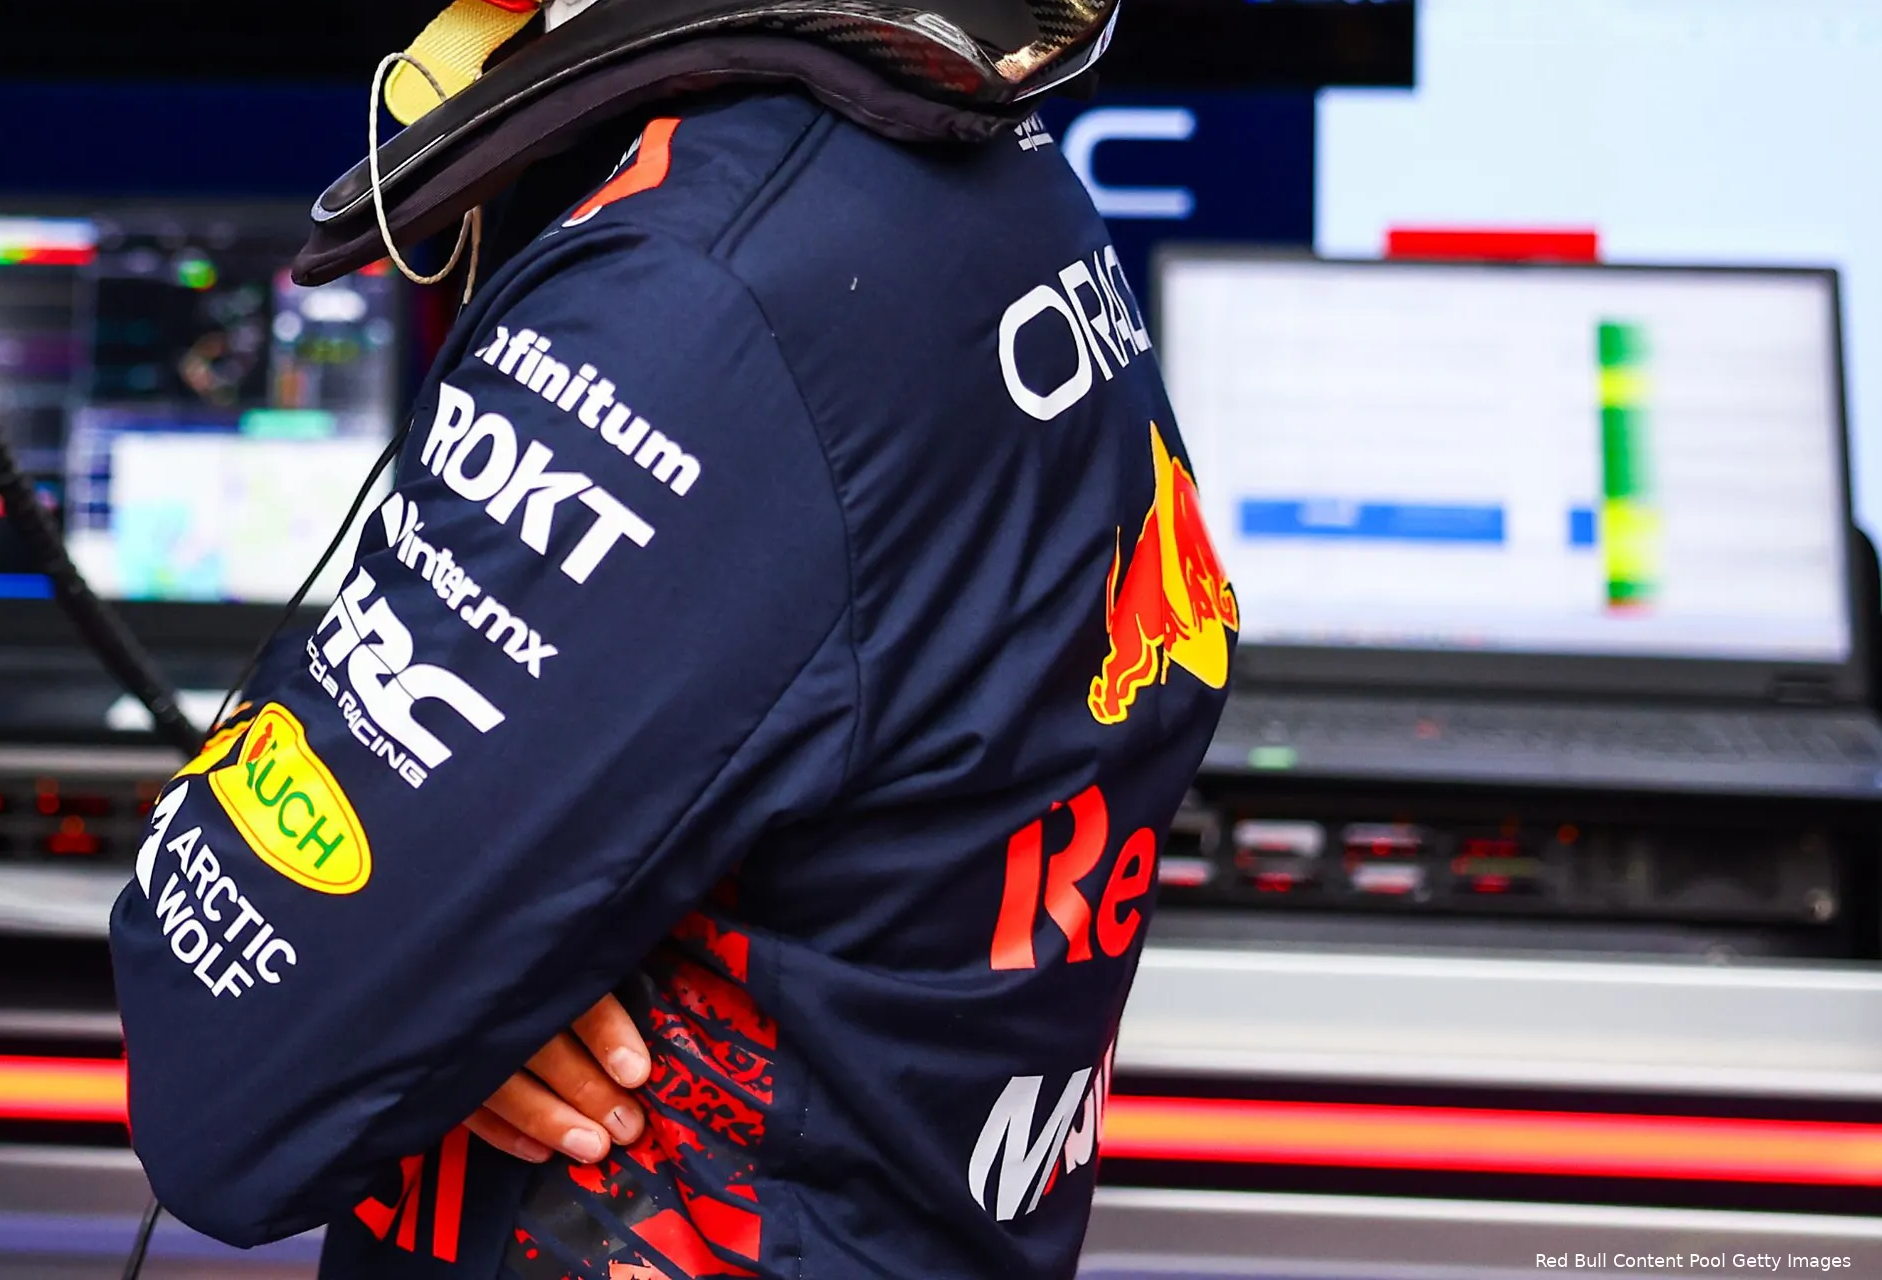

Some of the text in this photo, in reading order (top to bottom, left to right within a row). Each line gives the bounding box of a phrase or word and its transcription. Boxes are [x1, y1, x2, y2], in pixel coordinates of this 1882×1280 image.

[421, 382, 655, 584] ROKT
[316, 565, 506, 769] HRC
[338, 690, 427, 789] RACING
[156, 872, 255, 998] WOLF
[166, 826, 297, 984] ARCTIC
